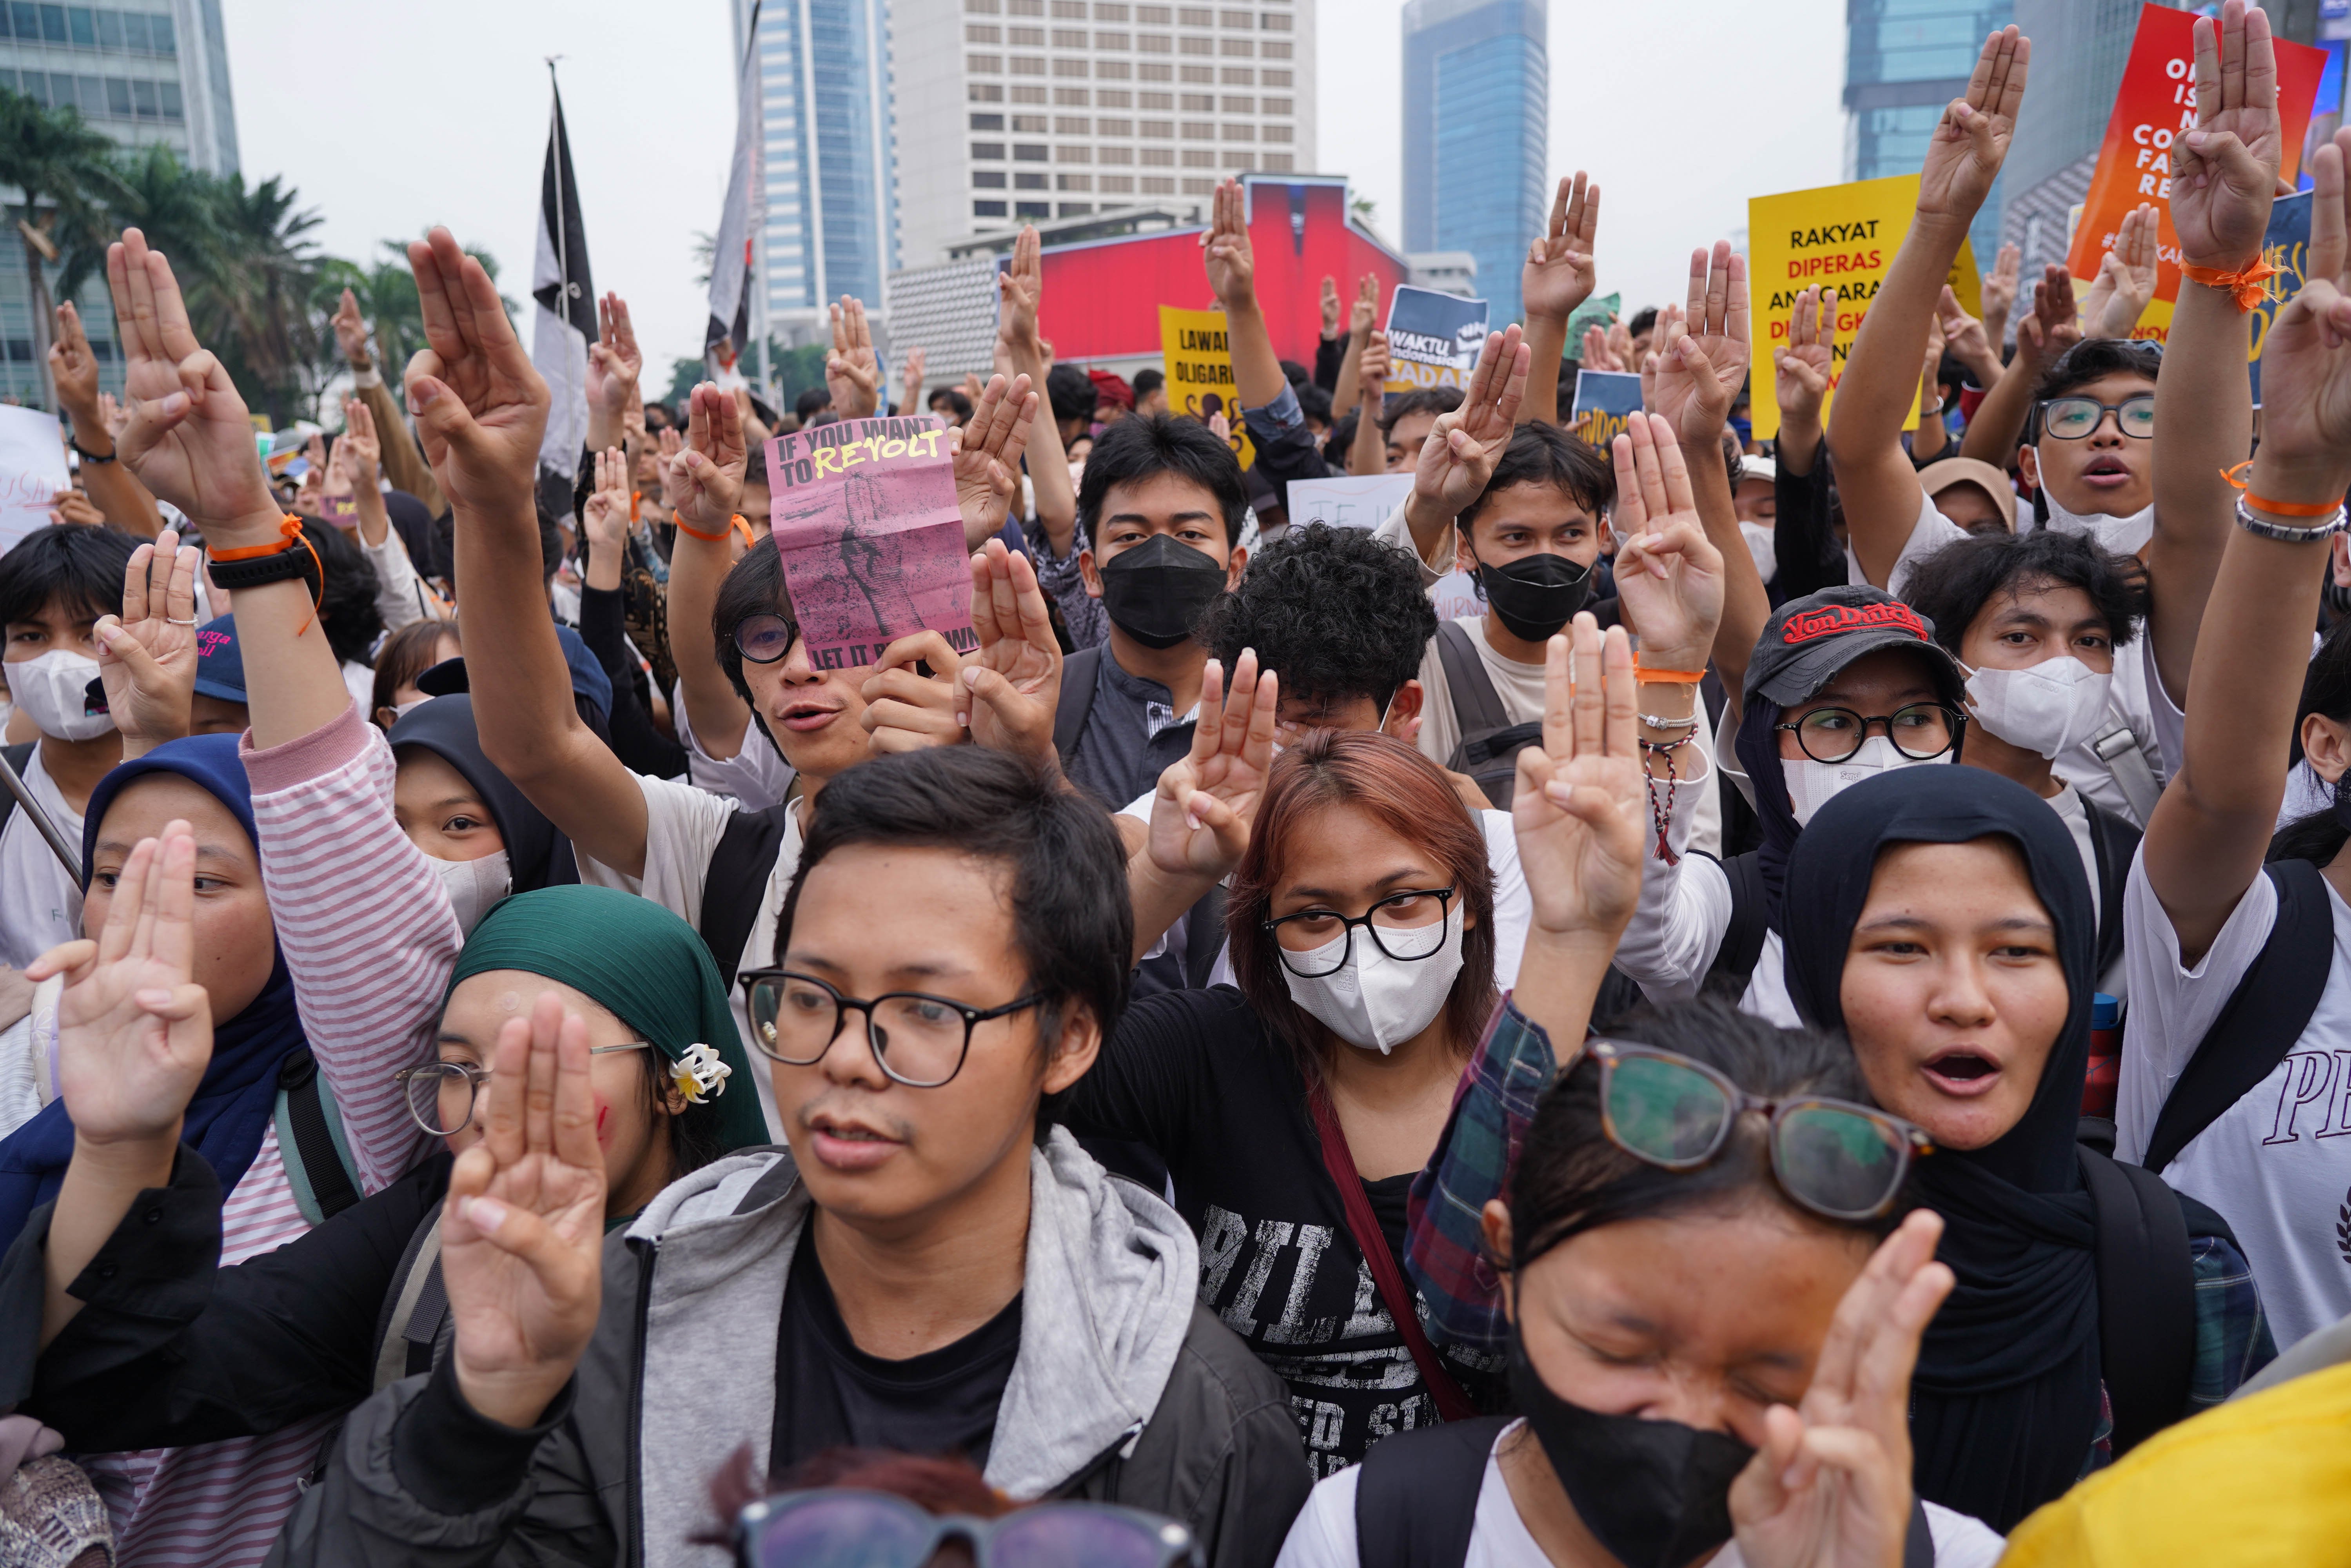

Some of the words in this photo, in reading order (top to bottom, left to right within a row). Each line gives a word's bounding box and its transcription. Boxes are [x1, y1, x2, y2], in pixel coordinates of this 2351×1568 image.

[1790, 219, 1879, 249] RAKYAT
[1788, 250, 1881, 279] DIPERAS
[1389, 328, 1451, 357] WAKTU
[1385, 359, 1472, 391] SADAR
[777, 436, 797, 462] IF
[804, 423, 853, 454] YOU
[860, 418, 934, 441] WANT
[780, 458, 813, 488] TO
[813, 429, 944, 479] REVOLT
[1781, 606, 1841, 644] Von
[1839, 601, 1927, 640] Dutch
[196, 631, 231, 644] arga
[812, 647, 844, 671] LET
[849, 644, 869, 667] IT
[1840, 771, 1861, 782] Sensi
